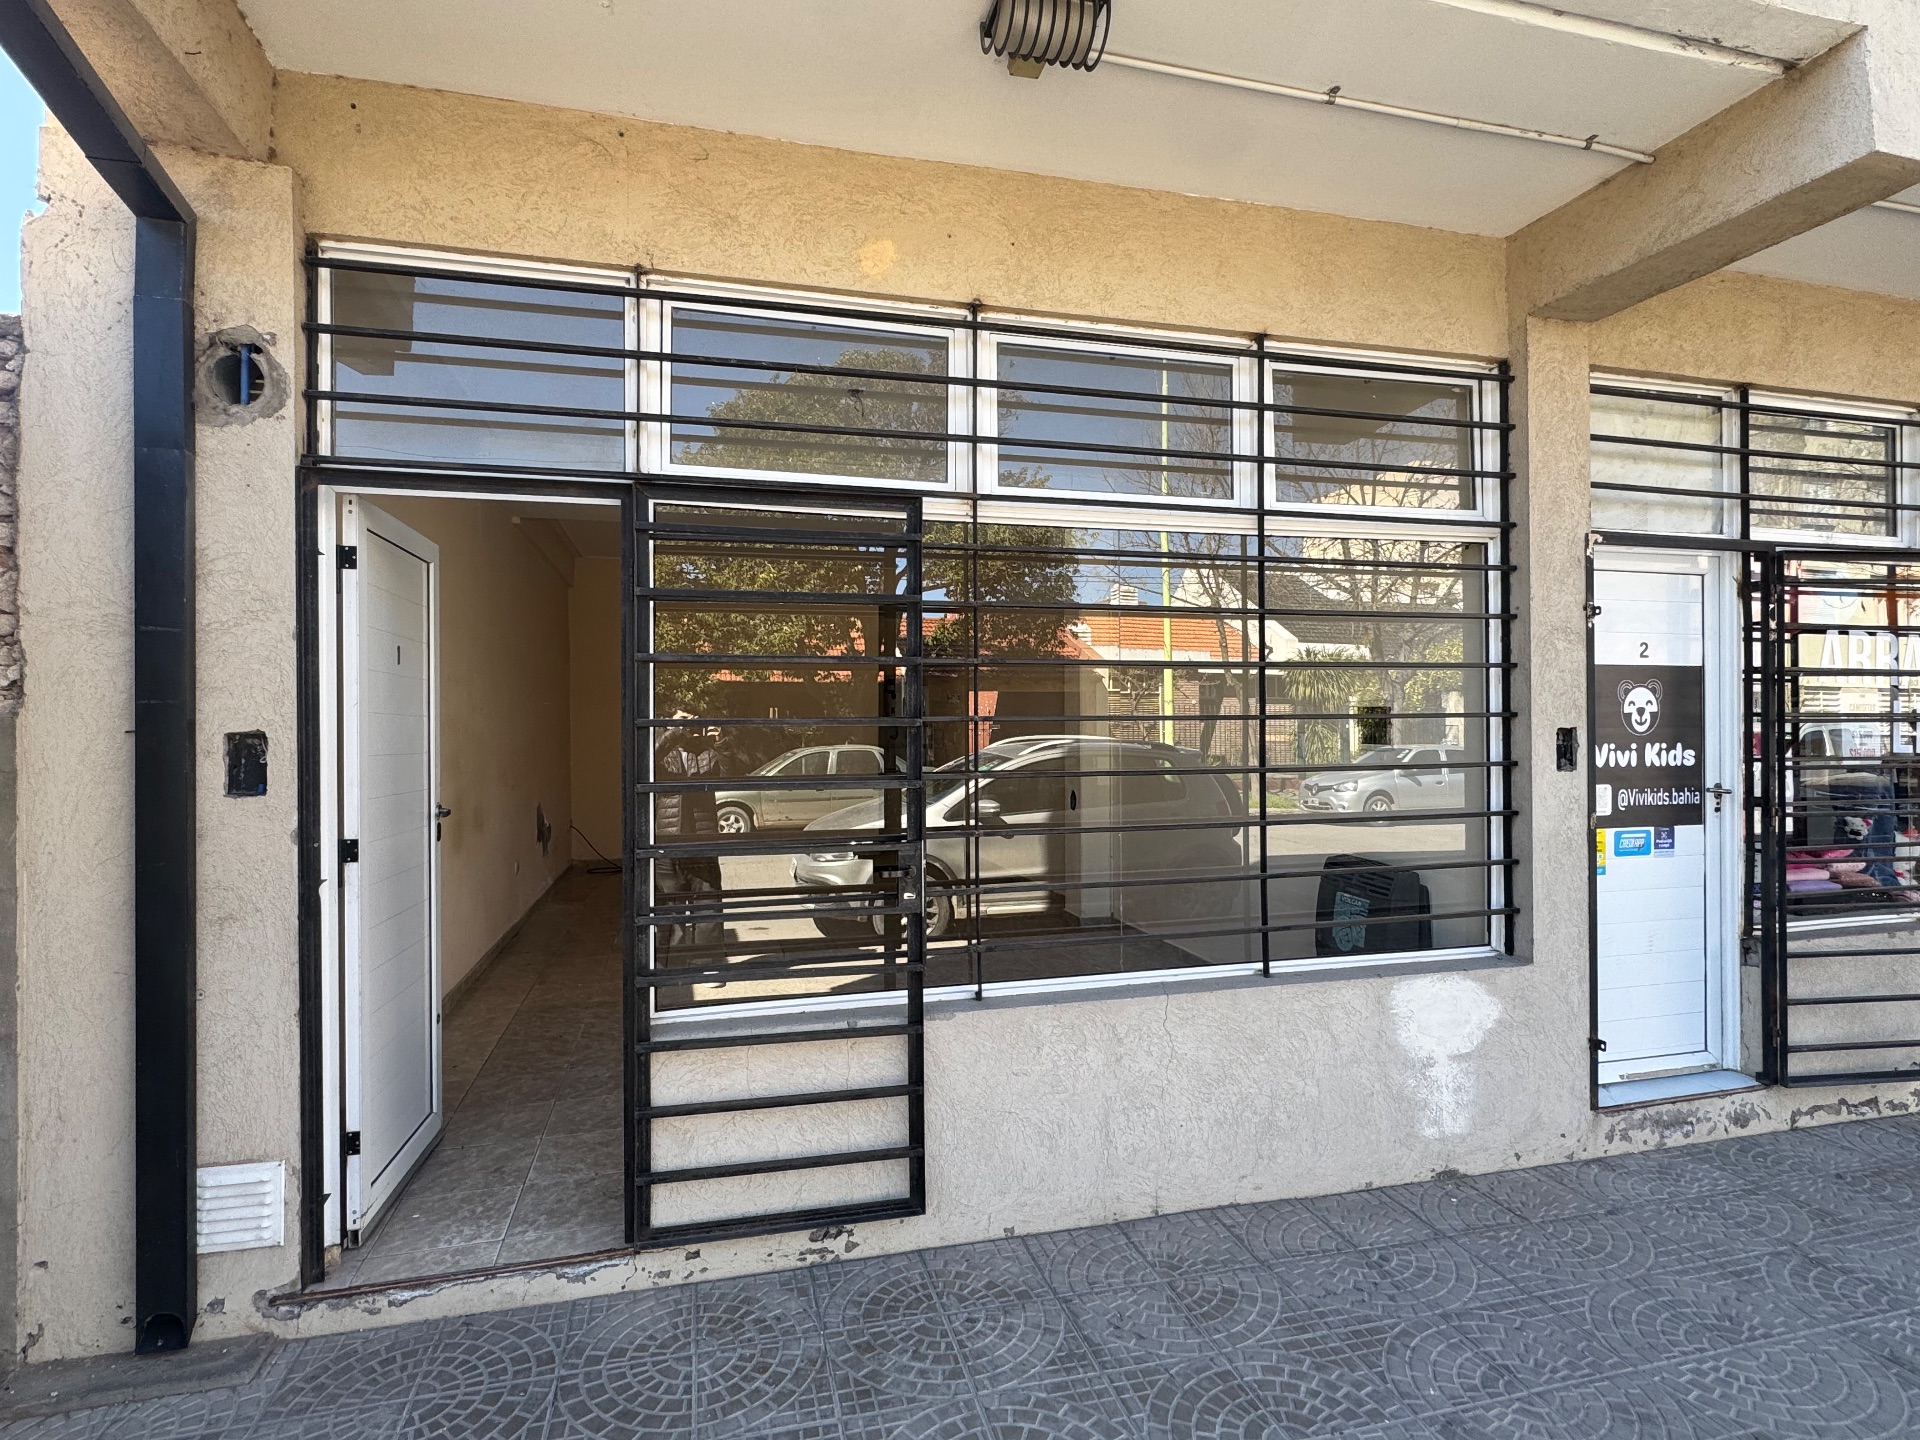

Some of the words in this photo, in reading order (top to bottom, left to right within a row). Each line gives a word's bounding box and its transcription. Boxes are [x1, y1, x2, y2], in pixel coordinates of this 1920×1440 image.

[1639, 641, 1650, 659] 2
[1595, 743, 1638, 768] Vivi
[1644, 742, 1696, 767] Kids
[1617, 787, 1701, 811] @Vivikids.bahia
